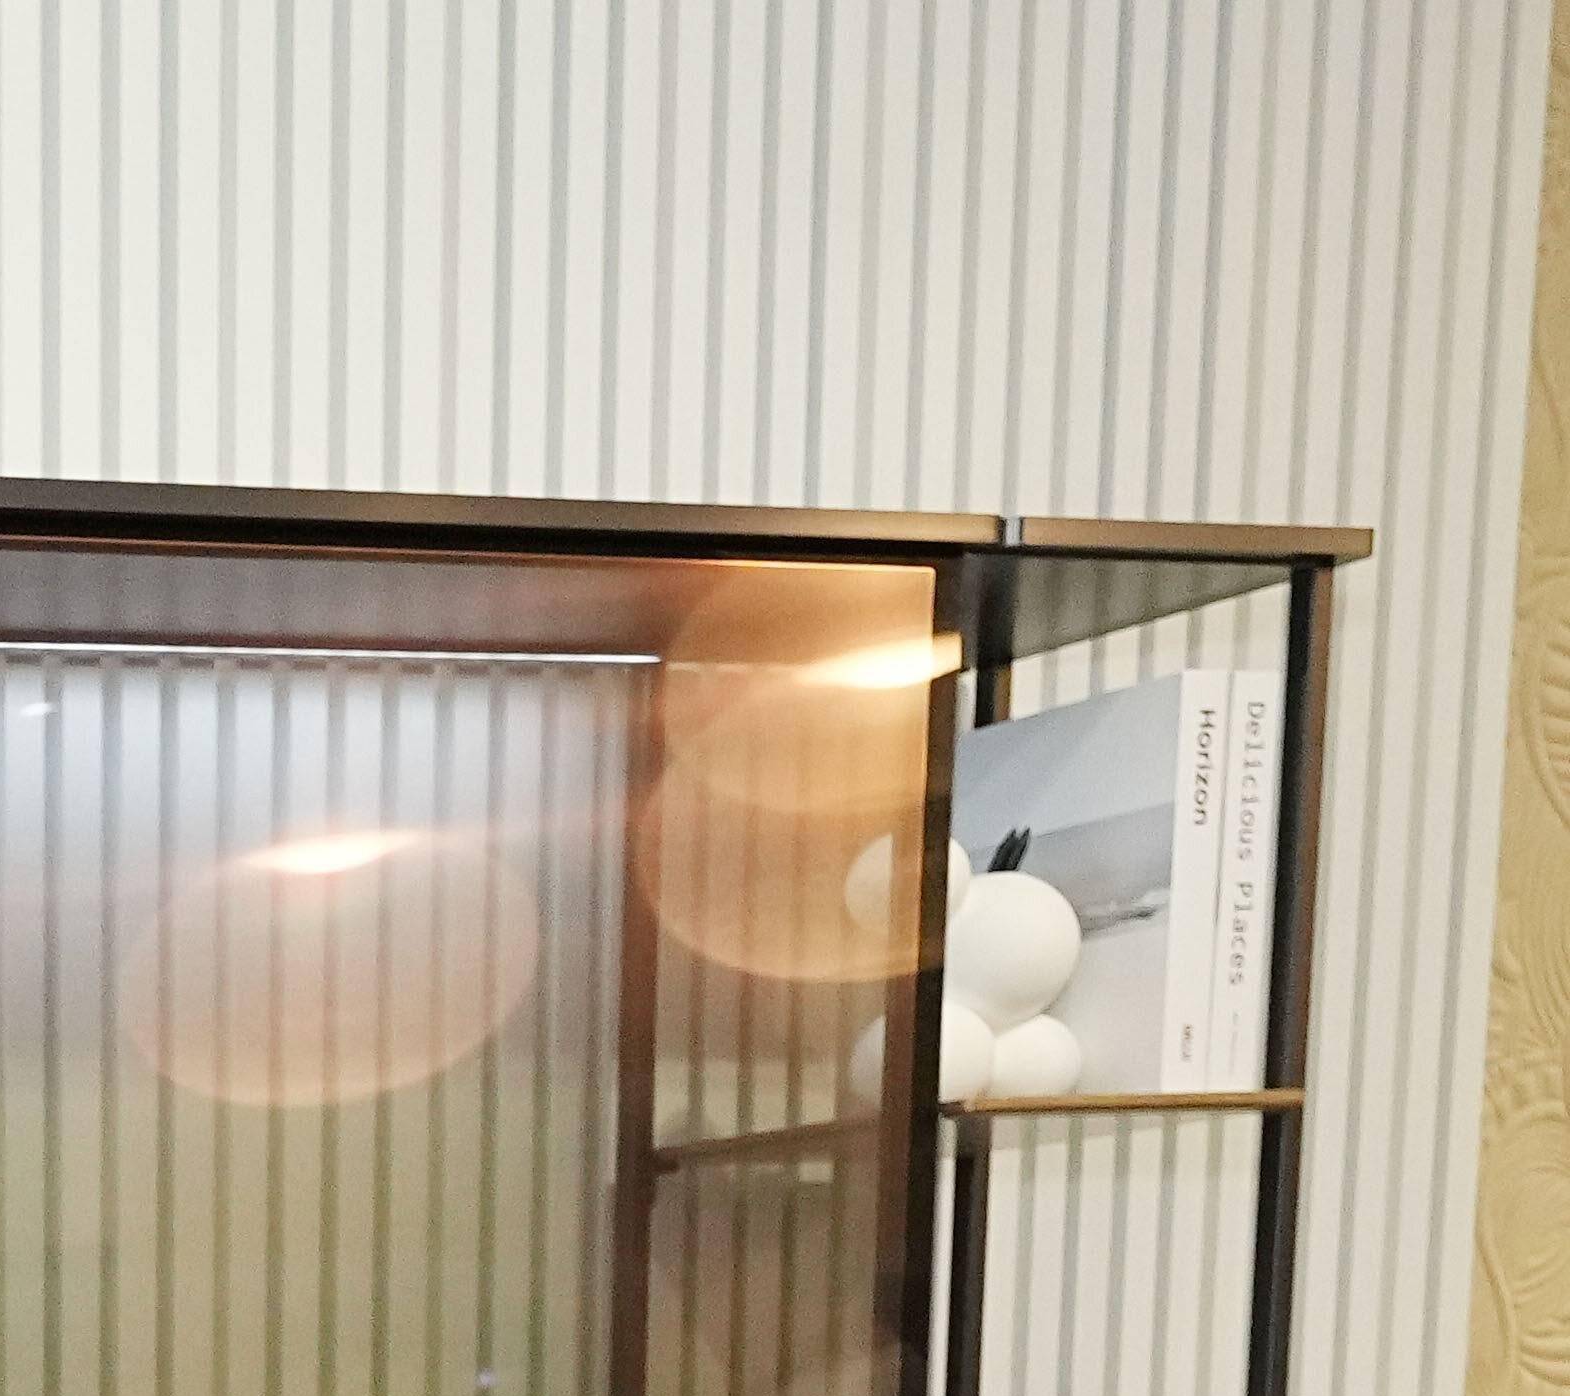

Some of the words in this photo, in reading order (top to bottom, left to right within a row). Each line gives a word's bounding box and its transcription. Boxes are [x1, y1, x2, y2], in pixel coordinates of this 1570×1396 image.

[1193, 709, 1215, 826] Horizon
[1237, 702, 1266, 860] Delicious
[1227, 882, 1254, 986] Places
